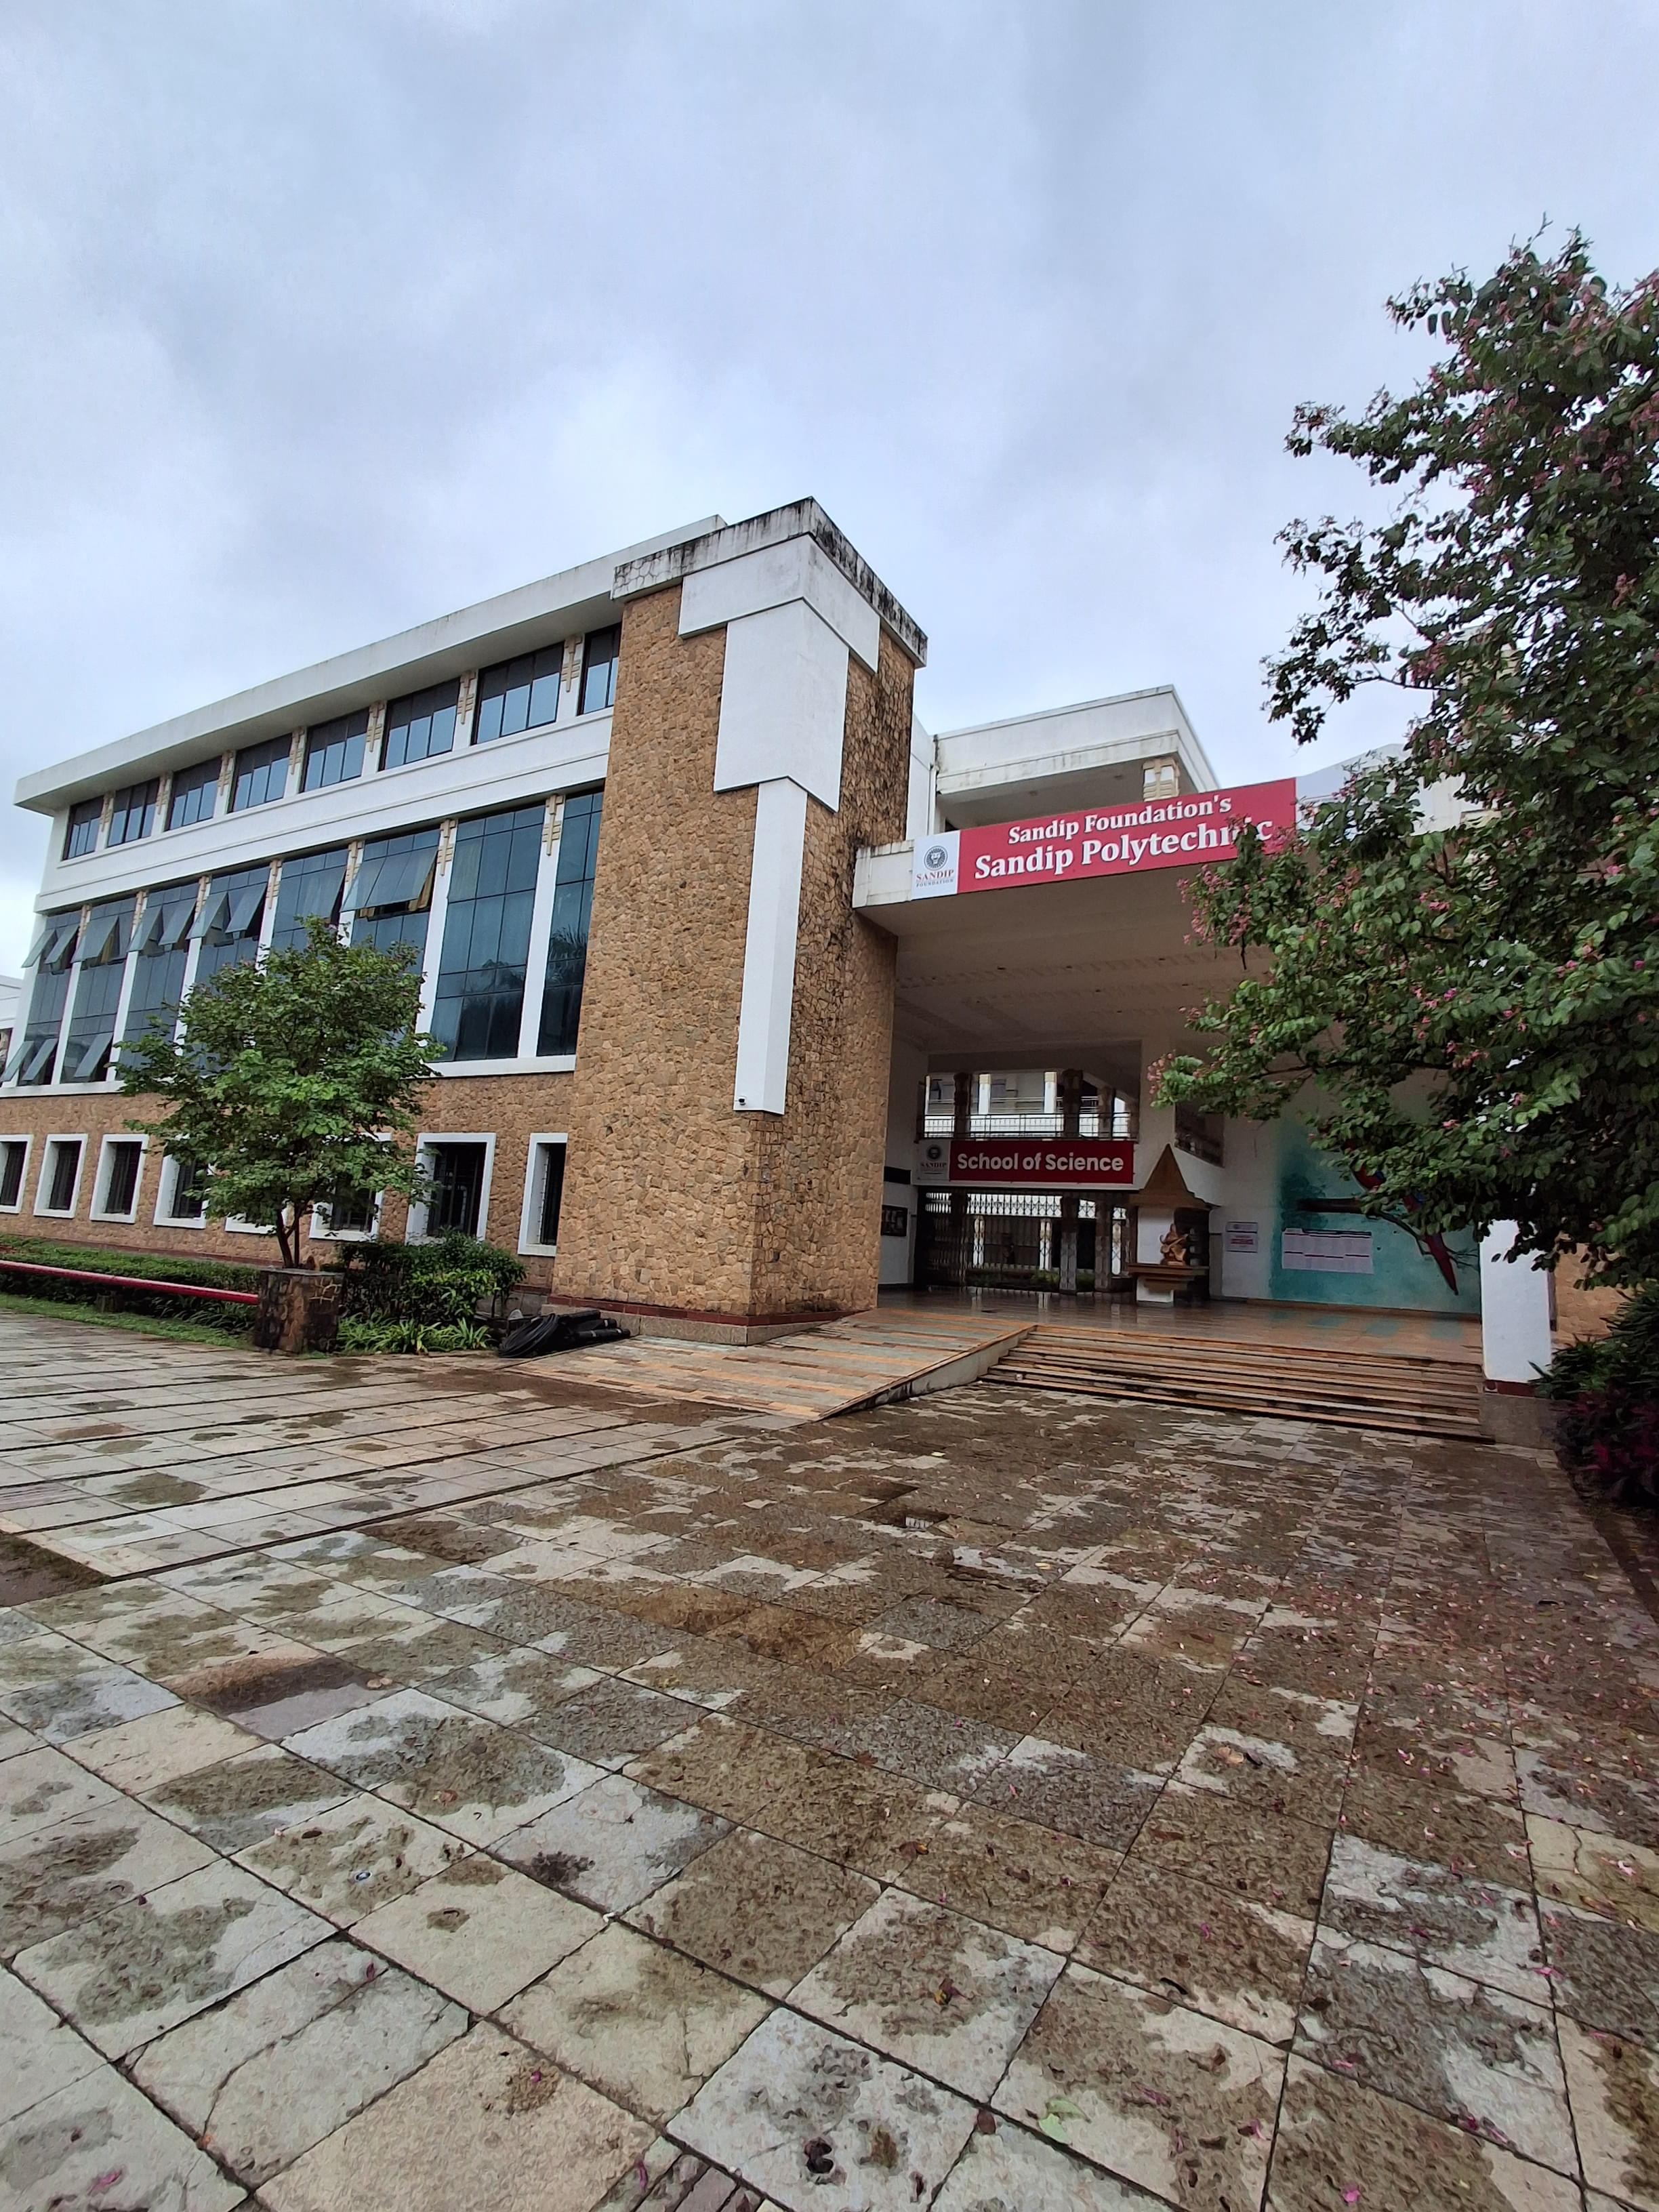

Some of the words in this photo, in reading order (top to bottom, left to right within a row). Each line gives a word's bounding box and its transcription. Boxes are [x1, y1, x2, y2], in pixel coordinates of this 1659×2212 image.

[1008, 819, 1080, 844] Sandip
[1084, 794, 1232, 833] Foundation's
[916, 869, 954, 881] SANDIP
[974, 844, 1074, 879] Sandip
[957, 1152, 1019, 1170] School
[1022, 1152, 1042, 1170] of
[1045, 1152, 1124, 1172] Science
